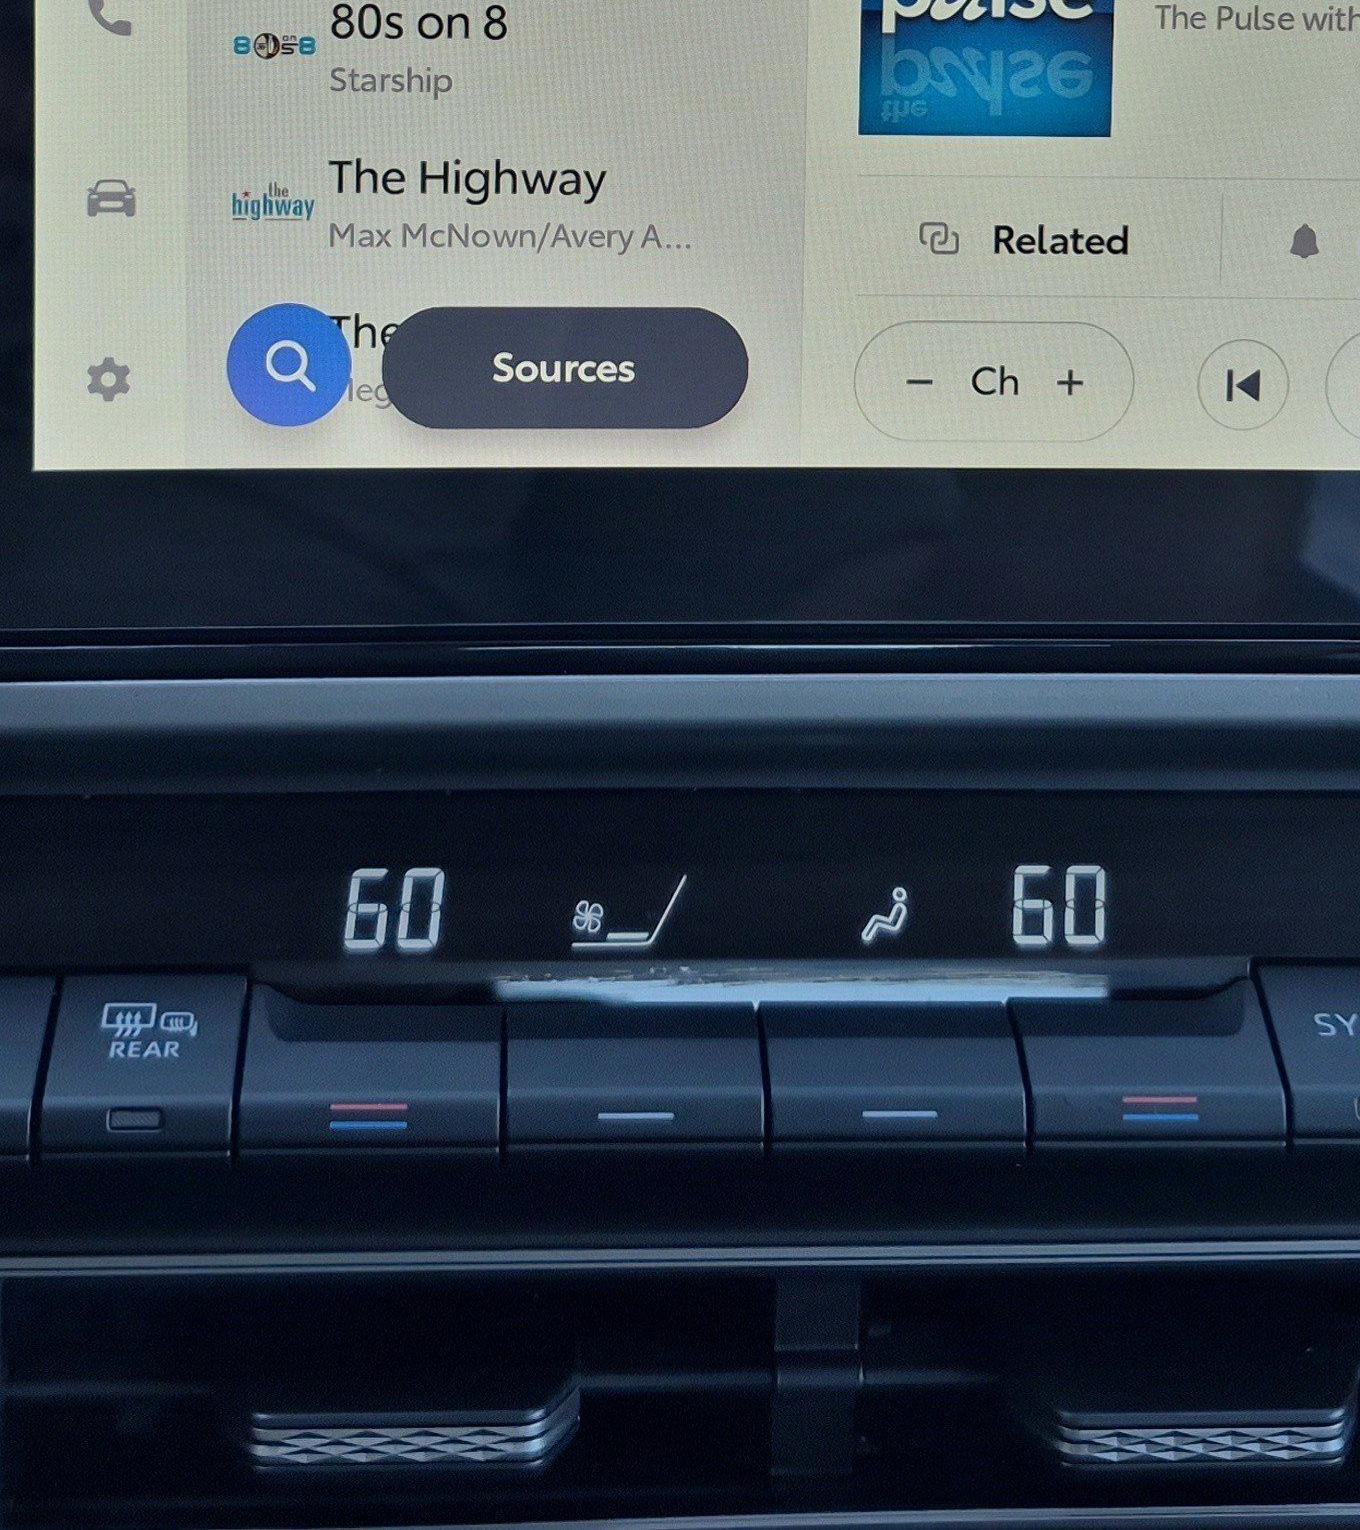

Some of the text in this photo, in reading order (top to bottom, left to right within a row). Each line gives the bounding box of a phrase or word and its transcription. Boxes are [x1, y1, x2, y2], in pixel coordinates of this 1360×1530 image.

[330, 4, 508, 41] 80s on 8
[1155, 4, 1207, 30] The
[1216, 5, 1296, 31] Pulse
[298, 36, 317, 56] 8
[329, 65, 454, 100] Starship
[268, 181, 290, 198] the
[328, 157, 608, 206] The Highway
[232, 189, 315, 221] highway
[329, 222, 393, 249] Max
[400, 222, 635, 257] McNown/Avery
[992, 224, 1130, 257] Related
[491, 351, 637, 385] Sources
[971, 366, 1020, 398] Ch
[342, 867, 445, 951] 60
[1011, 863, 1107, 948] 60
[108, 1040, 181, 1059] REAR
